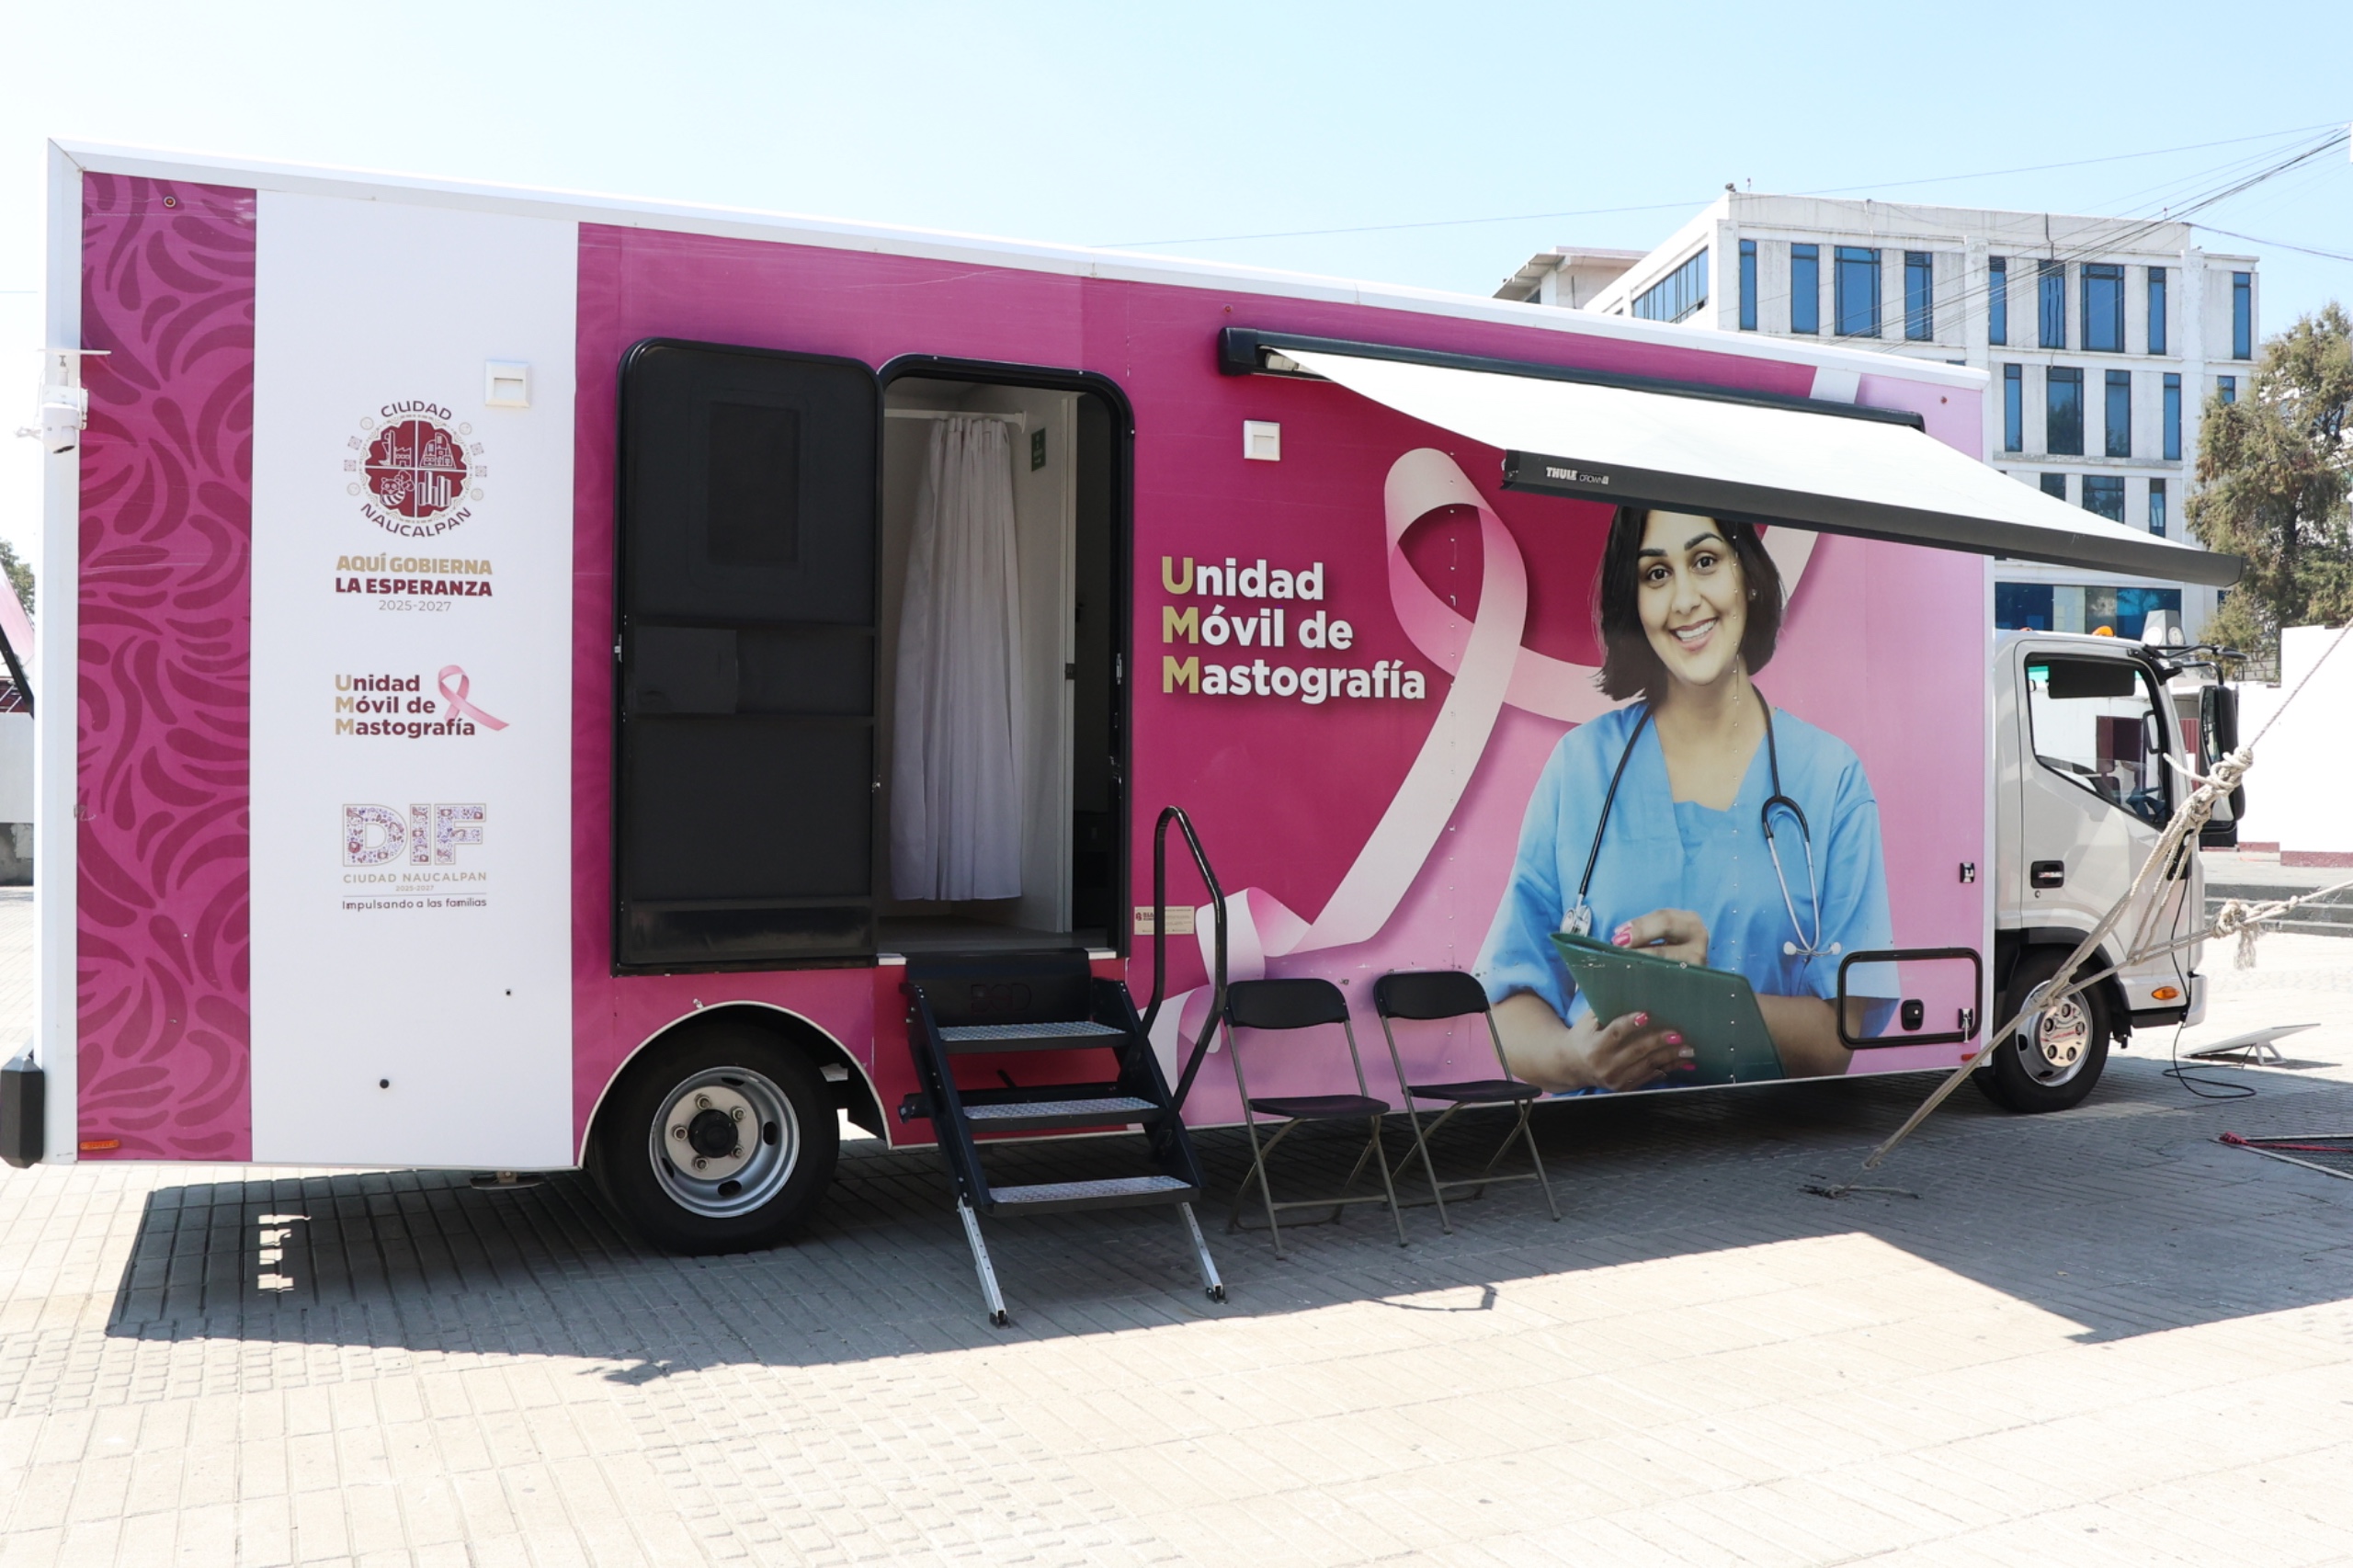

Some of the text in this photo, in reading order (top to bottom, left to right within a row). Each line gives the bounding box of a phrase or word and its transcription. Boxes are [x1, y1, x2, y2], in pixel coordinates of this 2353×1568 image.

[381, 401, 452, 421] CIUDAD
[1546, 467, 1578, 481] THULE
[360, 503, 472, 538] NAUCALPAN
[336, 552, 493, 574] AQUÍ GOBIERNA
[335, 577, 493, 597] LA ESPERANZA
[1162, 555, 1324, 600] Unidad
[379, 600, 452, 611] 2025-2027
[1162, 604, 1354, 650] Móvil de
[335, 675, 420, 691] Unidad
[1162, 654, 1426, 705] Mastografía
[335, 696, 436, 713] Móvil de
[335, 718, 476, 739] Mastografía
[342, 803, 486, 867] DIF
[343, 872, 487, 883] CIUDAD NAUCALPAN
[342, 900, 414, 912] Impulsando
[426, 898, 442, 908] las
[446, 897, 487, 908] familias
